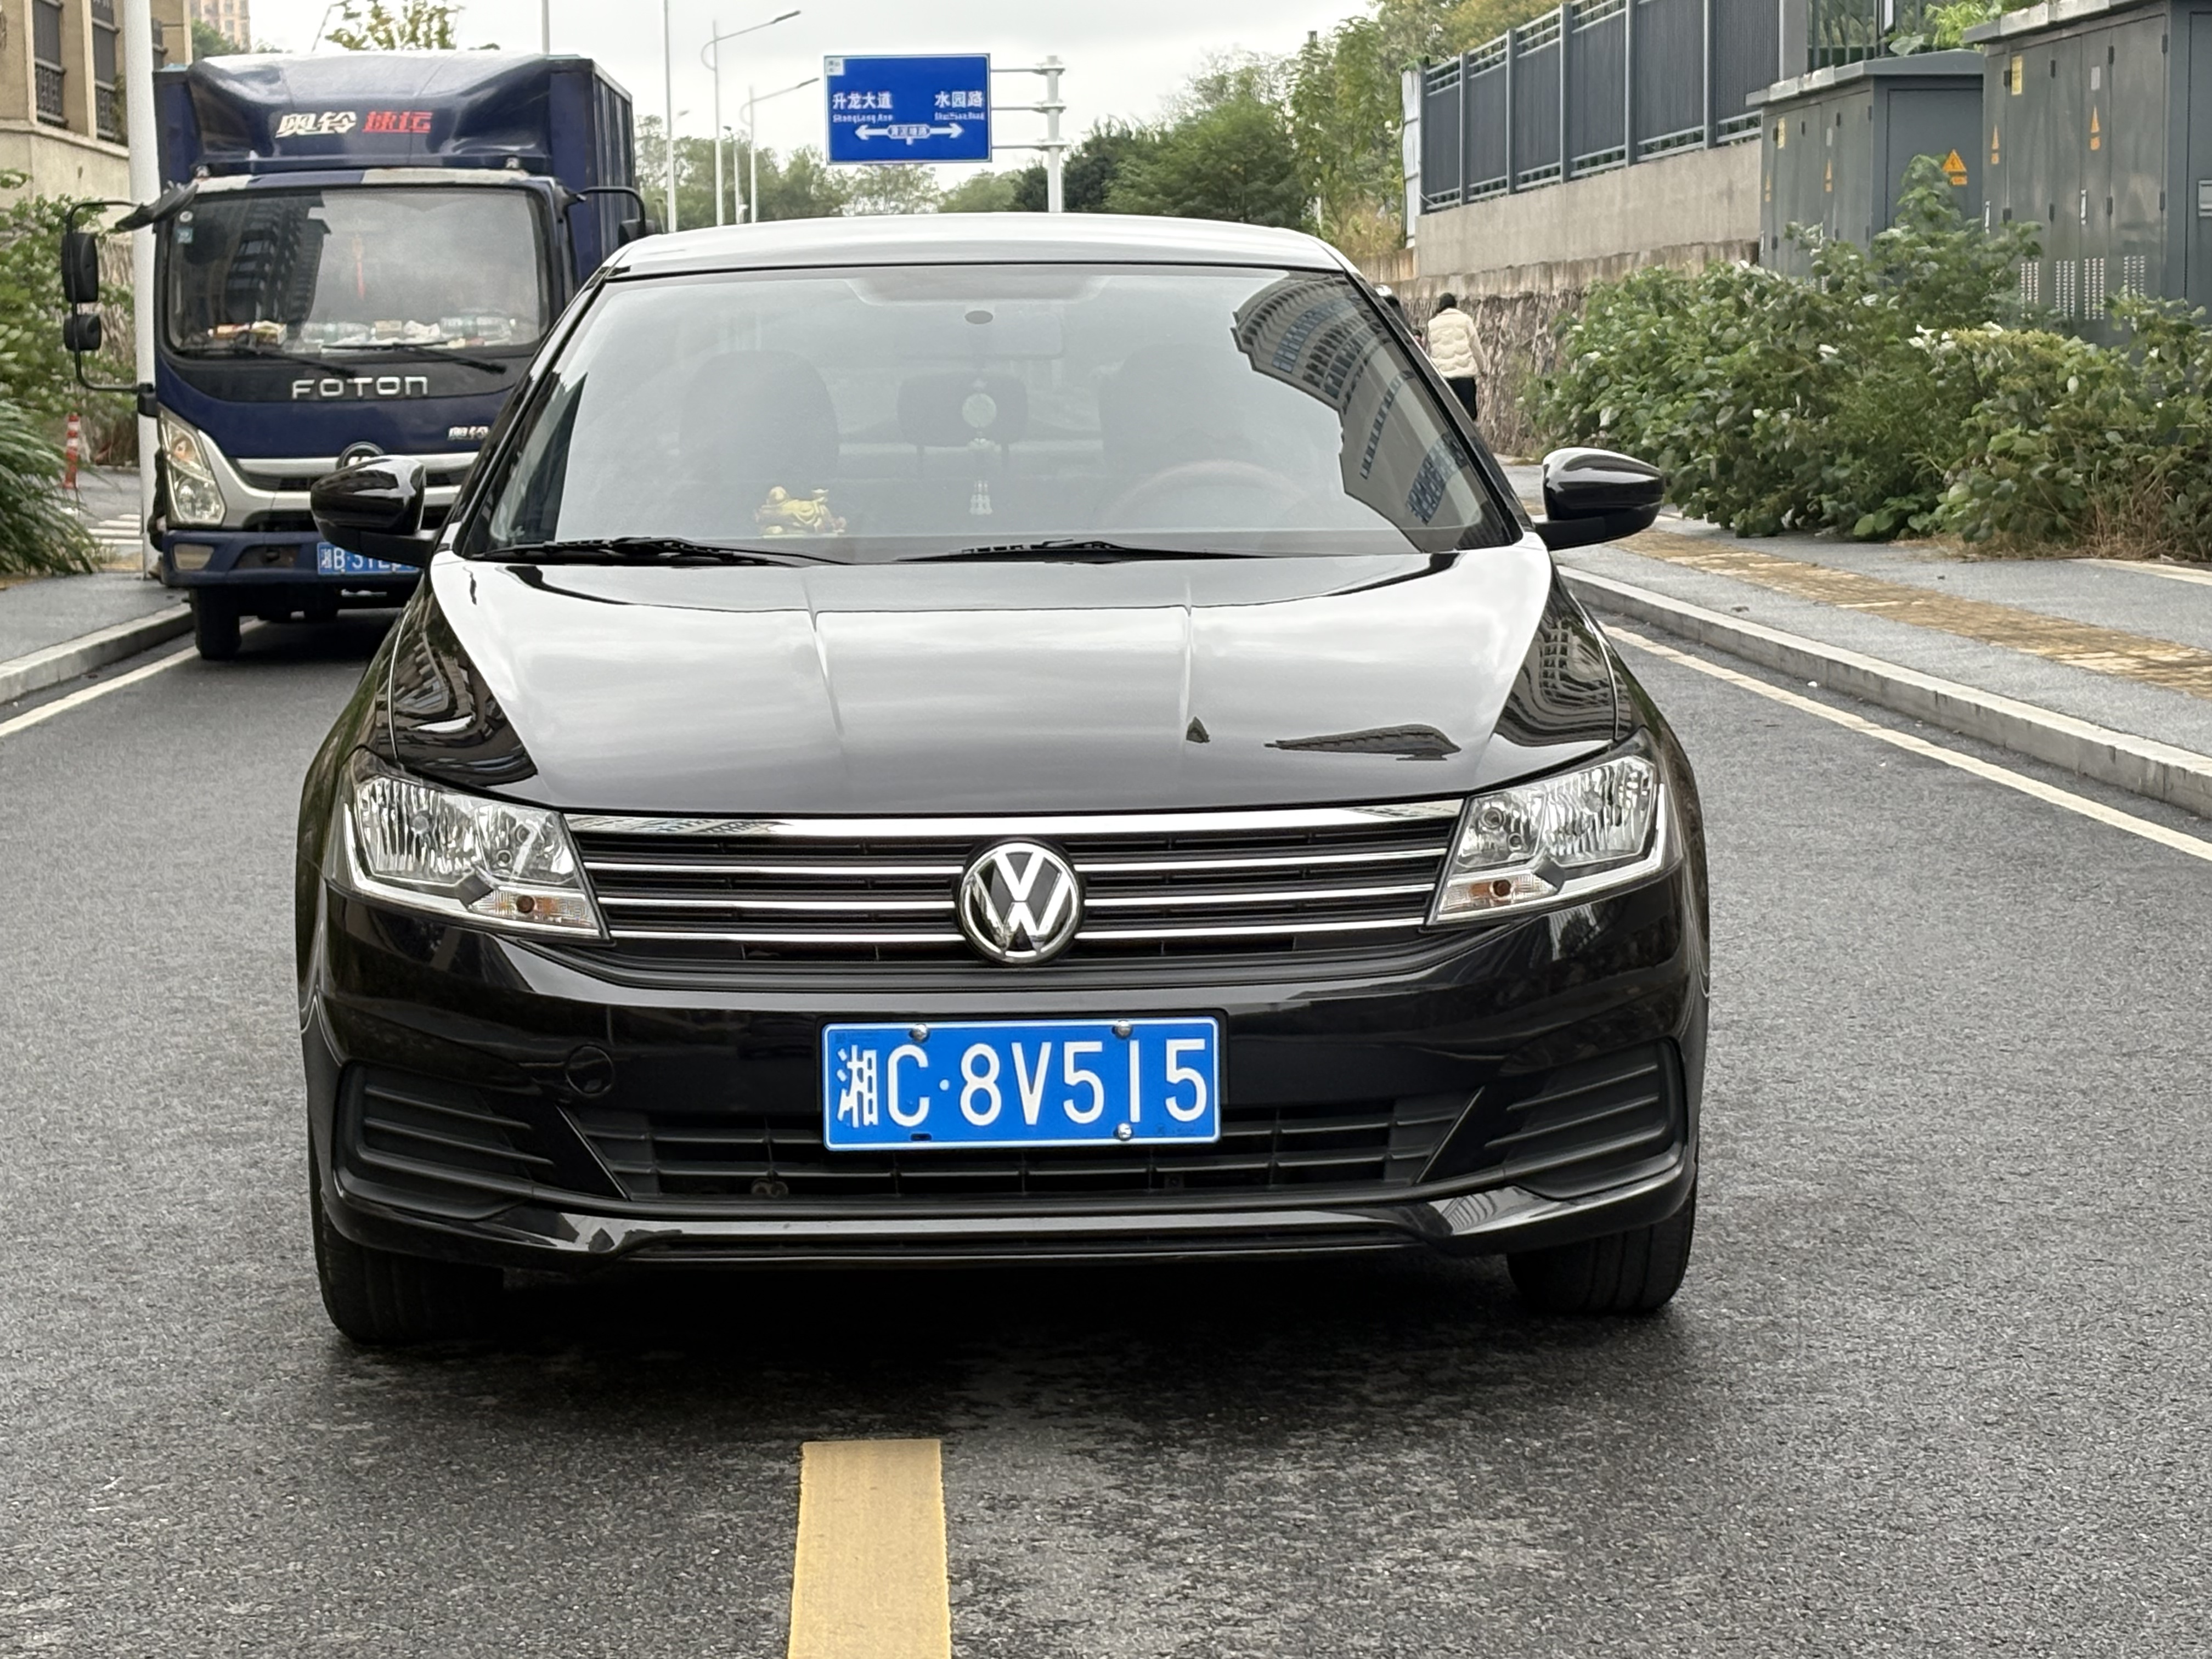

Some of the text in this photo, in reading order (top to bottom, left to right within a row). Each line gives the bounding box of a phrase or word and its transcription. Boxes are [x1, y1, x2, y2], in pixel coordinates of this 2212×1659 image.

[832, 91, 893, 110] 升龙大道
[934, 91, 983, 108] 水园路
[275, 111, 357, 138] 奥铃
[292, 376, 428, 399] FOTON
[836, 1039, 1208, 1128] 湘C·8V515
